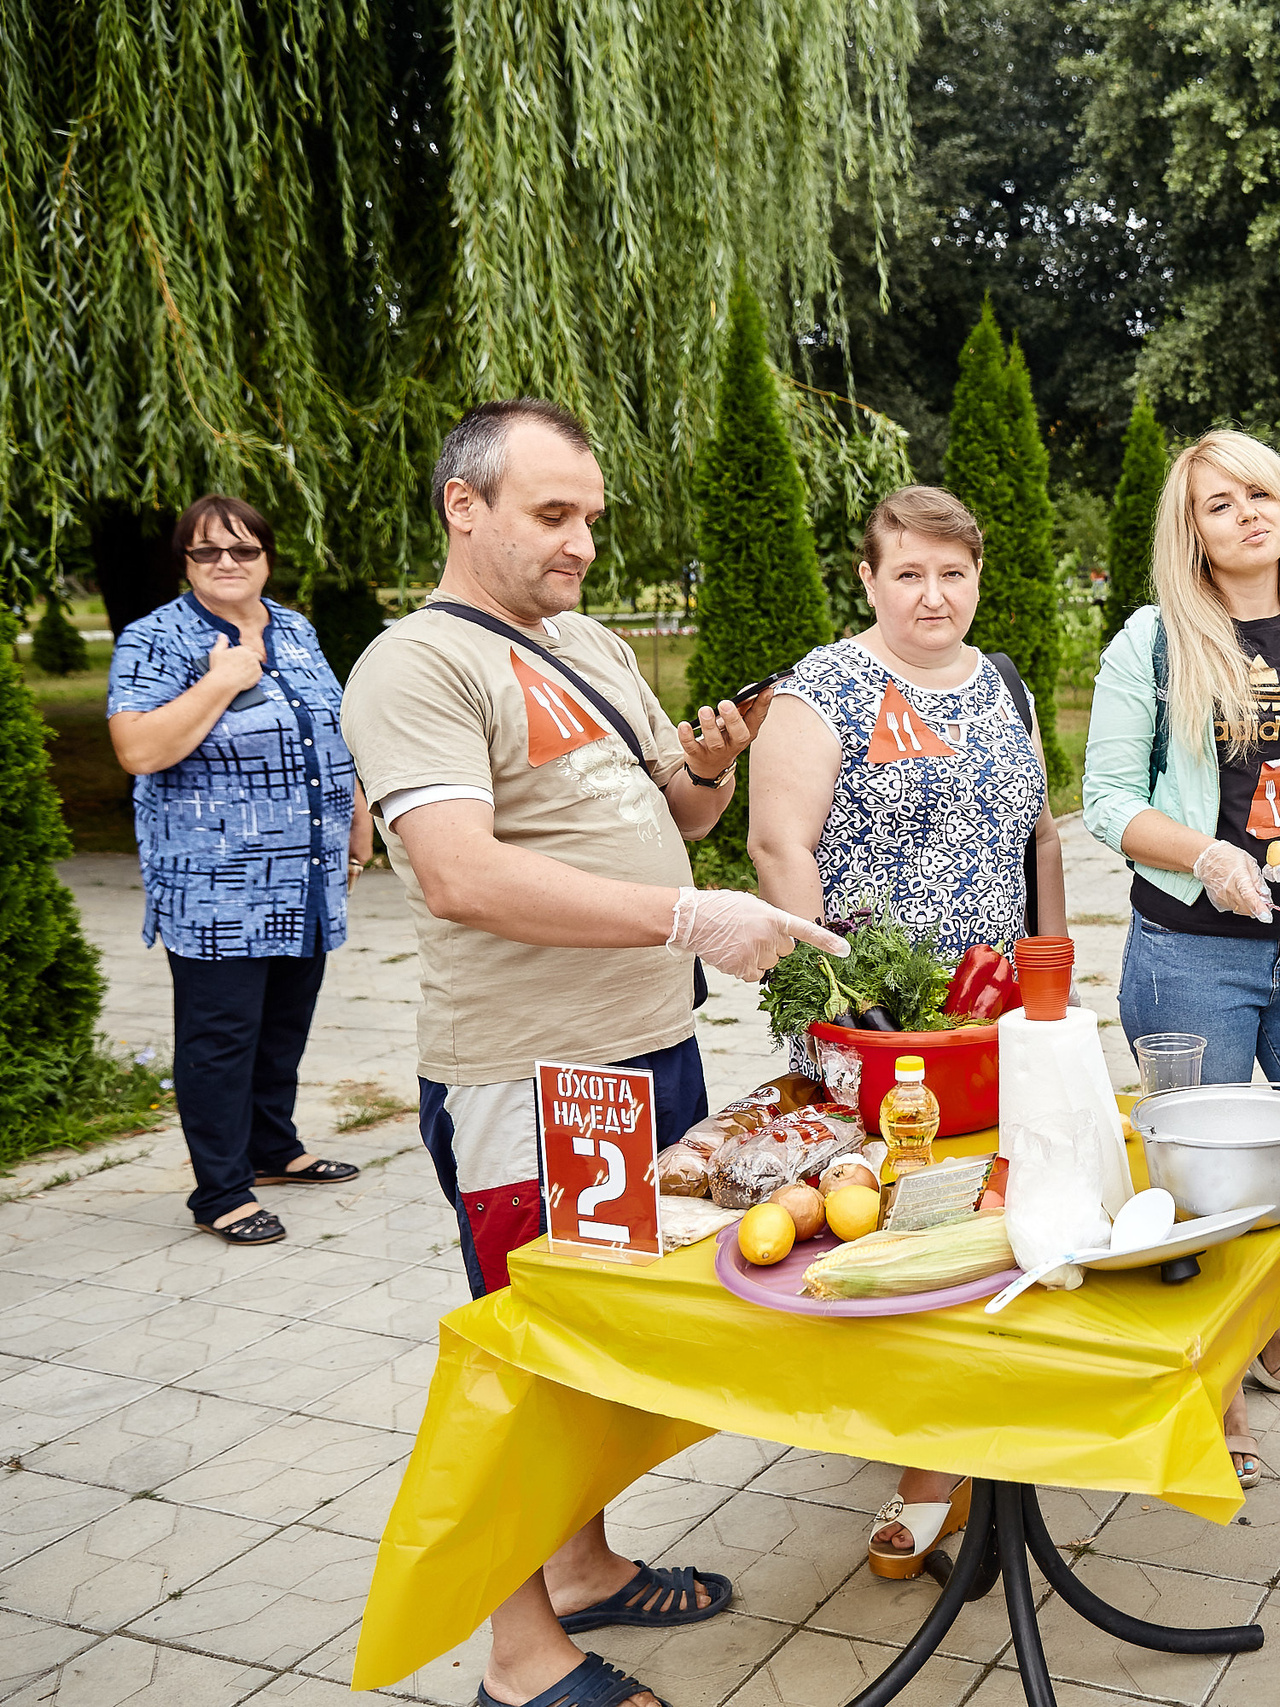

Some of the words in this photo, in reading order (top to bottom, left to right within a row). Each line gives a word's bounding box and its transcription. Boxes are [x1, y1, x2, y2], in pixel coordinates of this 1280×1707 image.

[557, 1072, 634, 1104] ОХОТА
[553, 1100, 584, 1128] НА
[589, 1104, 636, 1134] ЕДУ
[572, 1136, 630, 1244] 2
